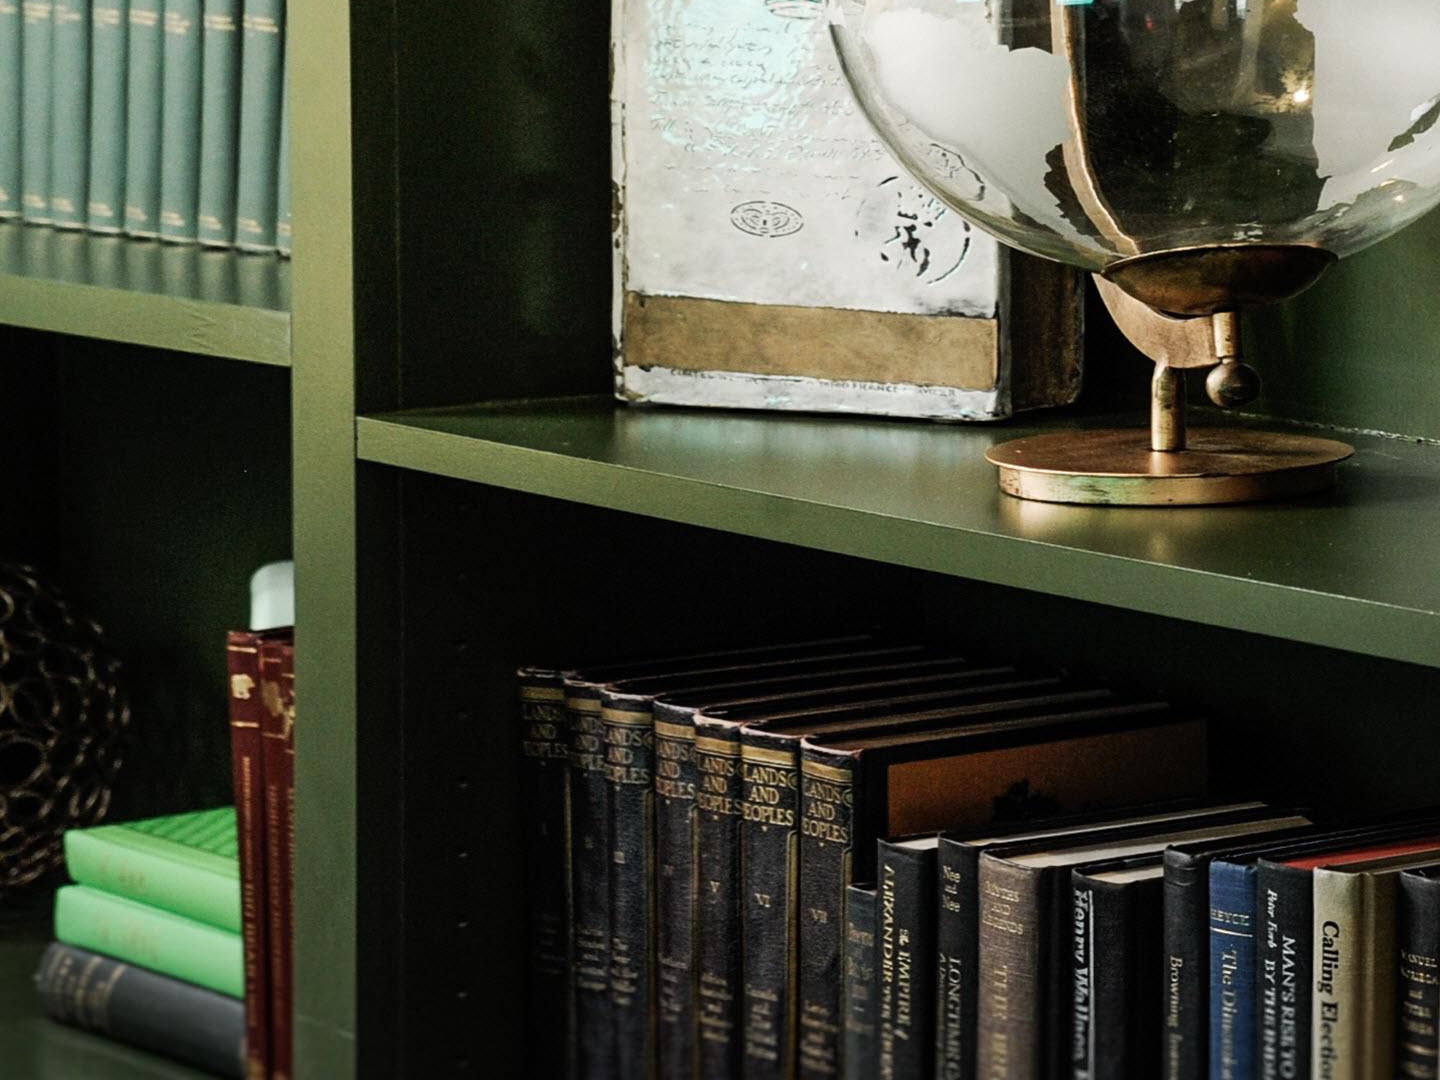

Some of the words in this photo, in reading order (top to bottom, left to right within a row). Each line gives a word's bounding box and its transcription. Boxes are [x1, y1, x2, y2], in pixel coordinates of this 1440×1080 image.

[703, 775, 728, 795] AND
[742, 763, 788, 788] LANDS
[748, 785, 780, 805] AND
[806, 800, 836, 821] AND
[741, 801, 795, 827] EOPLES
[801, 817, 849, 844] EOPLES
[882, 863, 896, 984] ALEXANDER
[1073, 887, 1090, 964] Henry
[1221, 949, 1238, 985] The
[1264, 958, 1277, 985] BY
[1281, 934, 1297, 1003] MAN'S
[1317, 920, 1341, 995] Calling
[896, 951, 912, 1025] EMPIRE
[1166, 955, 1184, 1028] Browning
[1263, 986, 1277, 1027] THE
